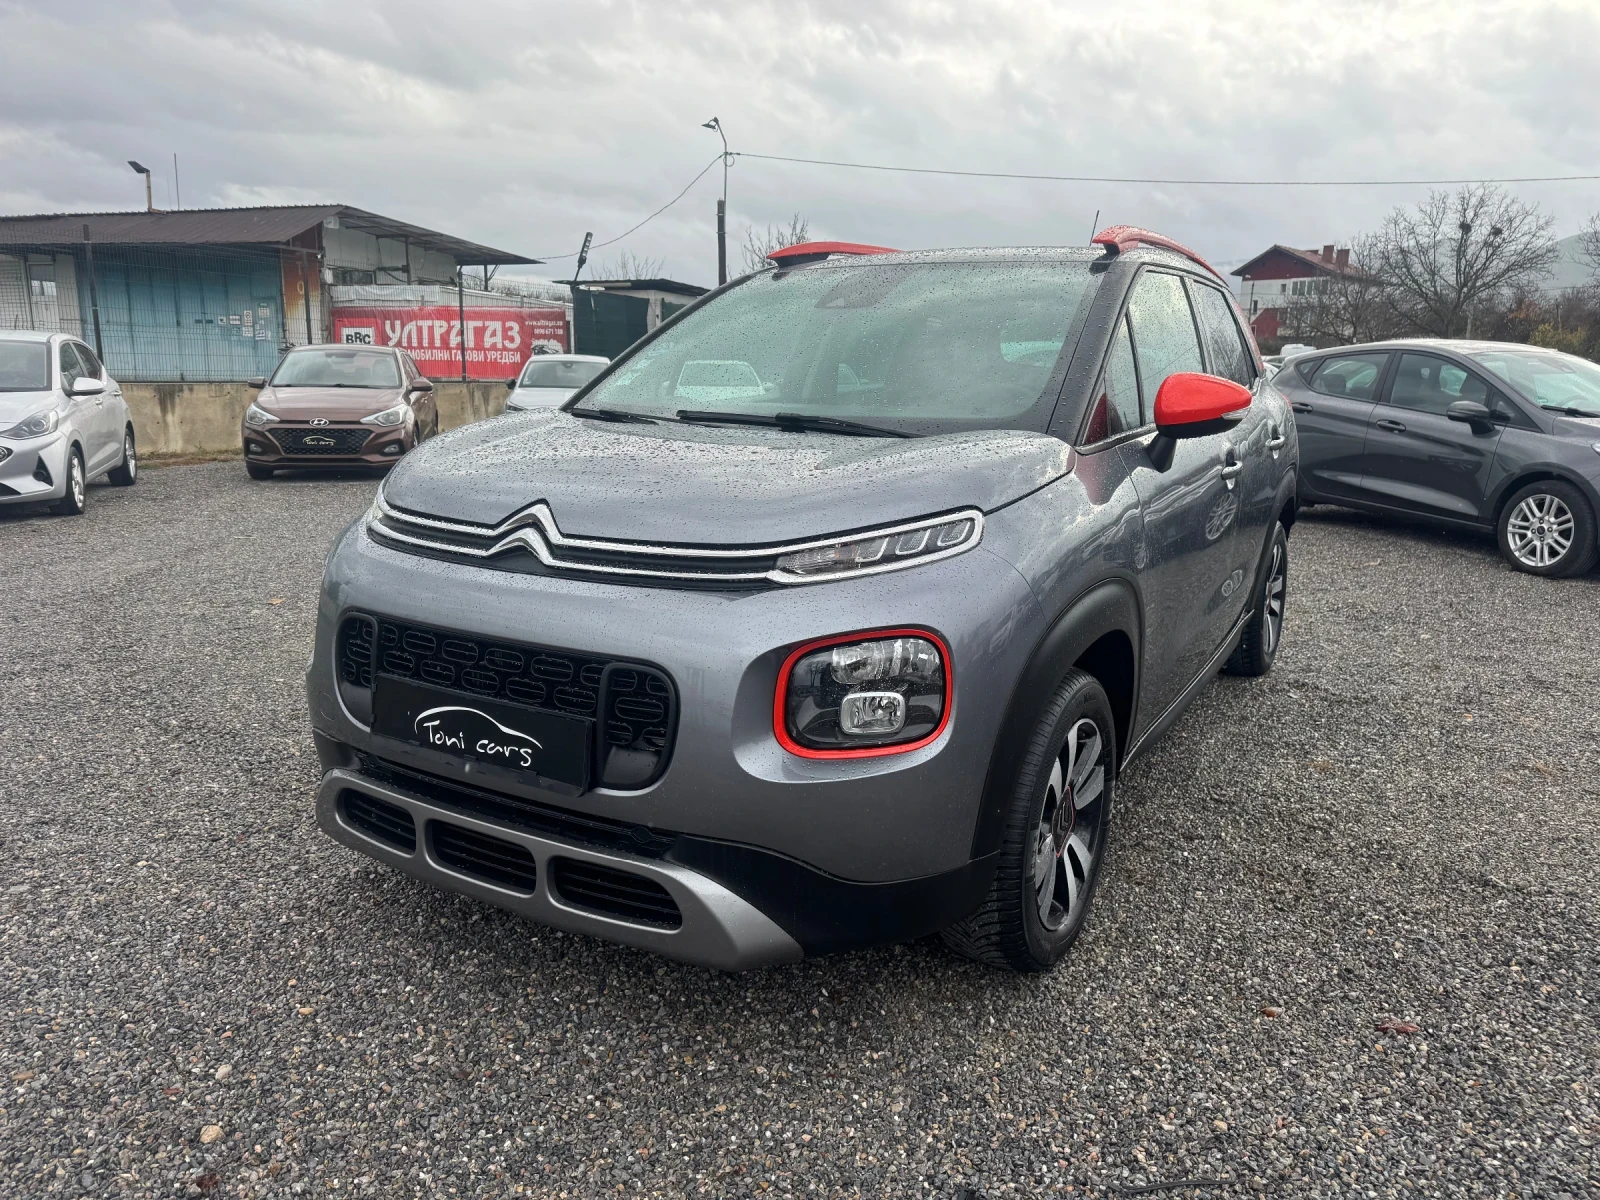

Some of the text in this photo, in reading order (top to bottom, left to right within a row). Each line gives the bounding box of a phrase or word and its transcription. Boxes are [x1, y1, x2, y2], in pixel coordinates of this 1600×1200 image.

[346, 332, 371, 344] BRC
[385, 320, 521, 349] УЛТРАГАЗ
[485, 351, 520, 364] УРЕДБИ
[423, 720, 532, 767] Toni cars
